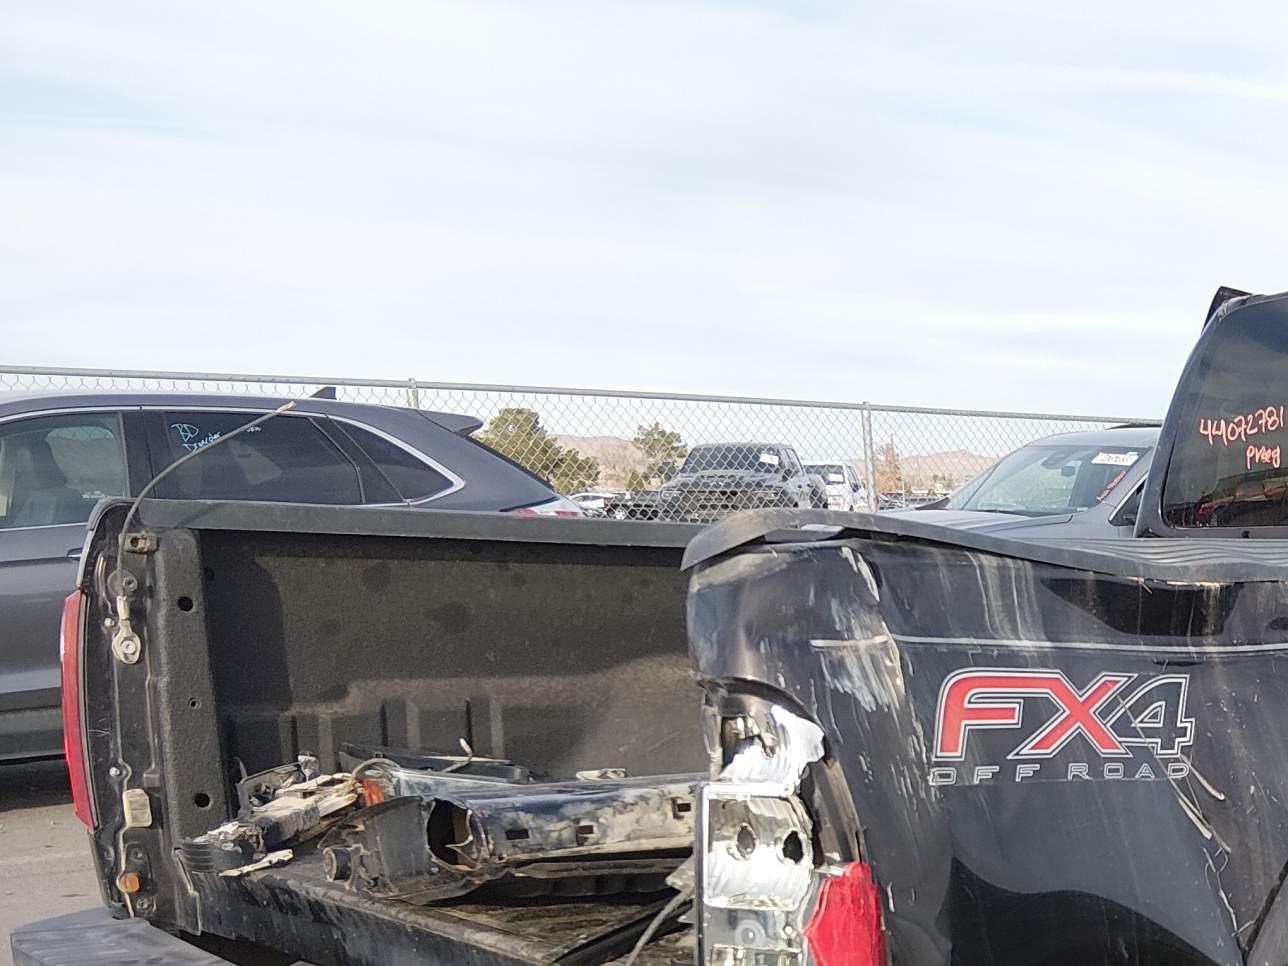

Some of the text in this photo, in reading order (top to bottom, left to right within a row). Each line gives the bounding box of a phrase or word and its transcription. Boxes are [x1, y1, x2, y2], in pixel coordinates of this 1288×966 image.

[1199, 405, 1285, 446] 44072781
[932, 667, 1195, 762] FX4
[929, 763, 1190, 786] OFF ROAD
